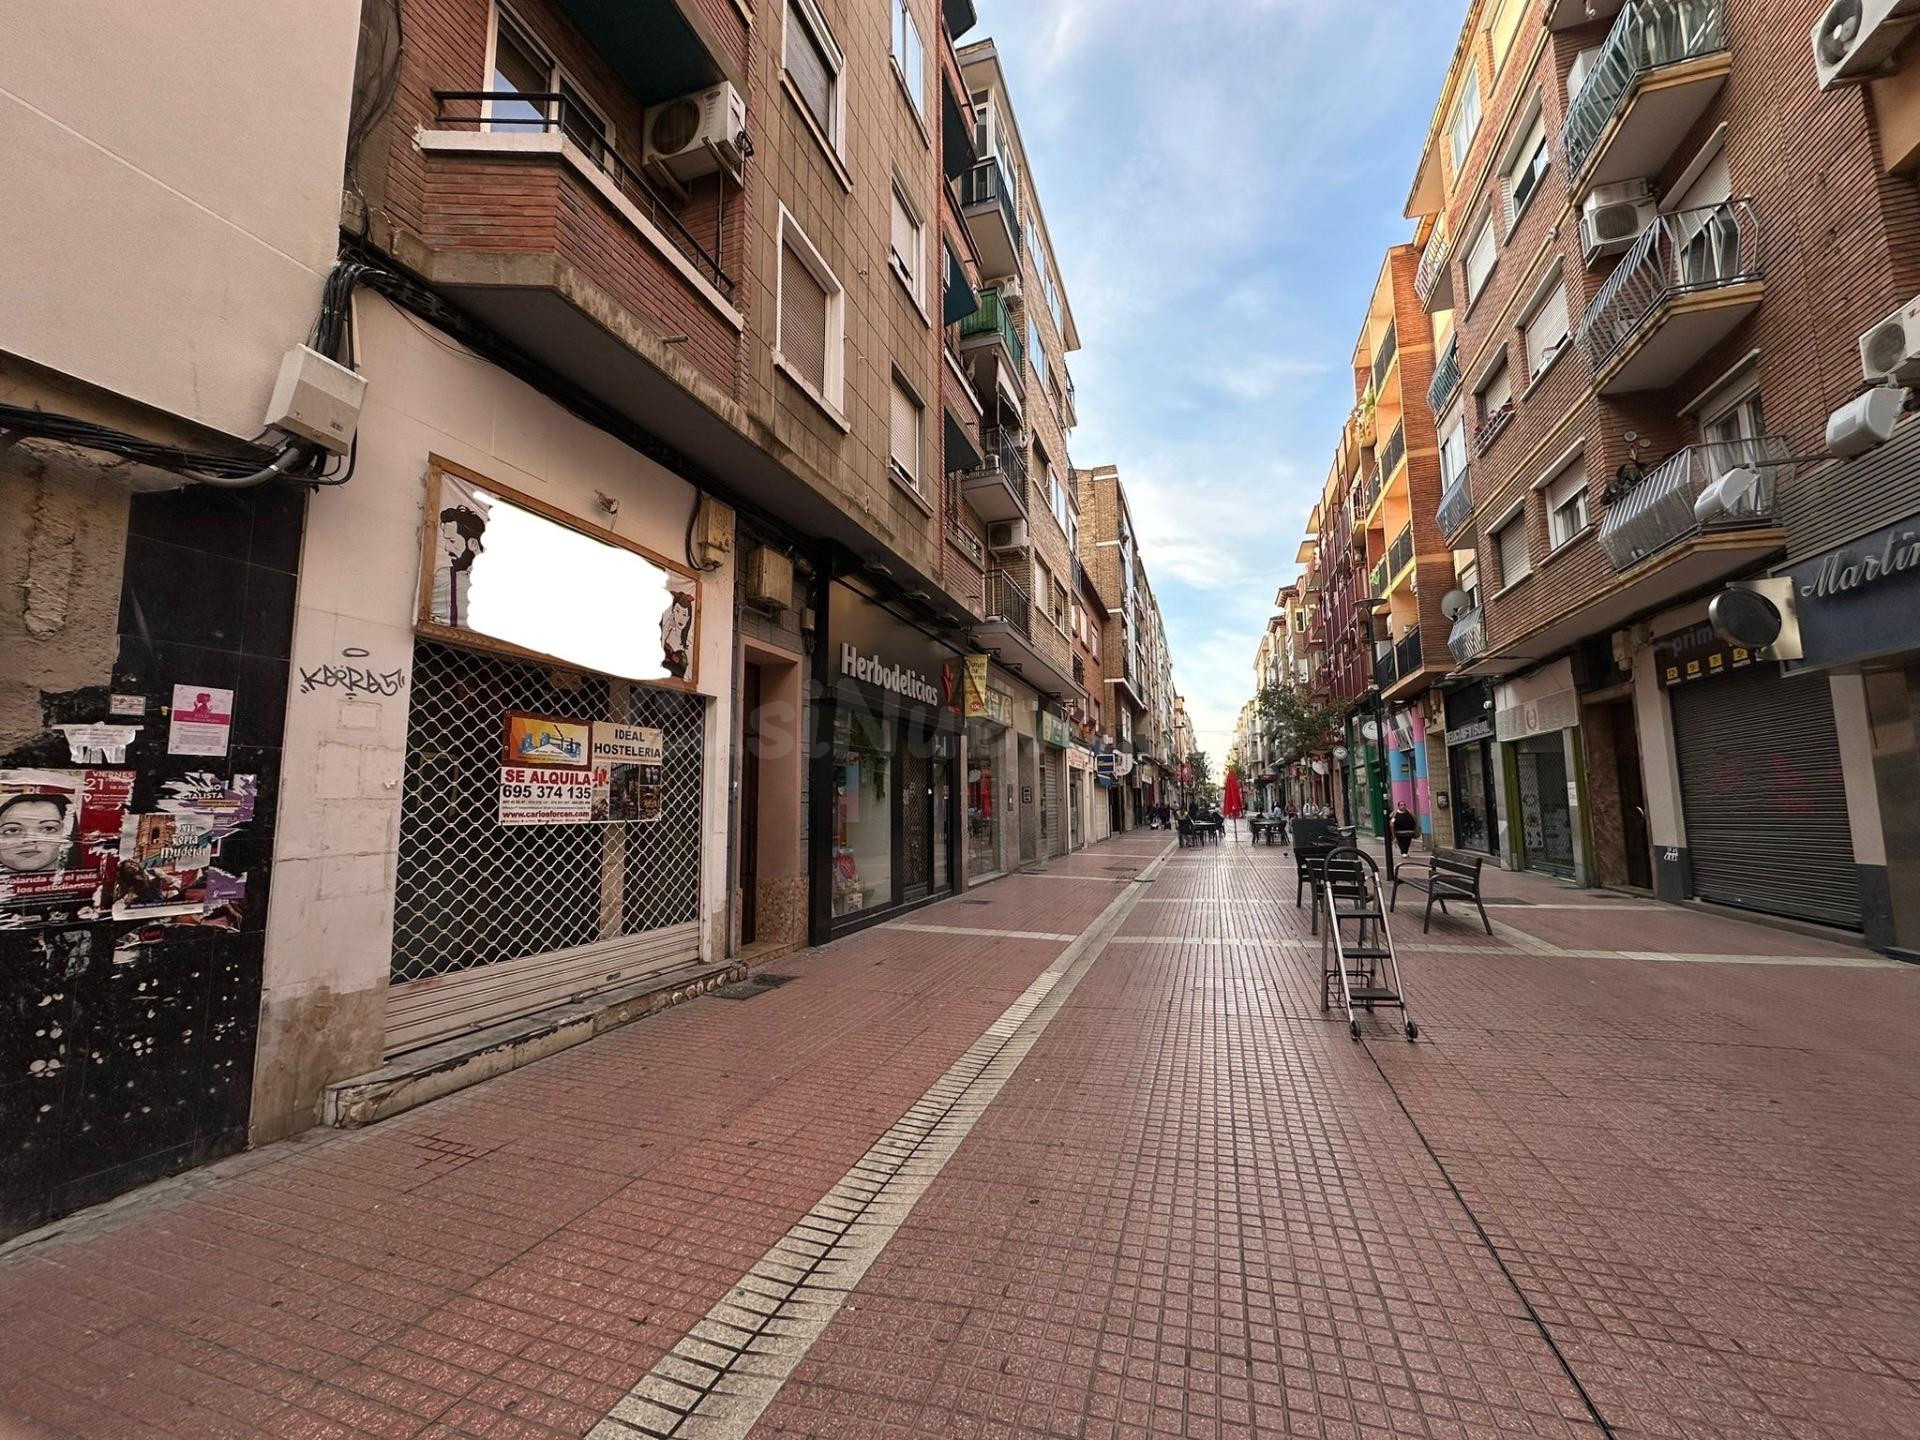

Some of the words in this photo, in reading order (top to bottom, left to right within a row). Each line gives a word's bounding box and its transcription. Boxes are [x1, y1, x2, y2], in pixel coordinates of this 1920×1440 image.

[1672, 625, 1714, 658] prim
[840, 642, 939, 706] Herbodelicias
[614, 728, 646, 742] IDEAL
[594, 743, 661, 759] HOSTELERIA
[85, 778, 104, 791] 21
[504, 769, 526, 784] SE
[529, 771, 592, 786] ALQUILA
[502, 785, 532, 799] 695
[536, 786, 563, 799] 374
[567, 787, 591, 800] 135
